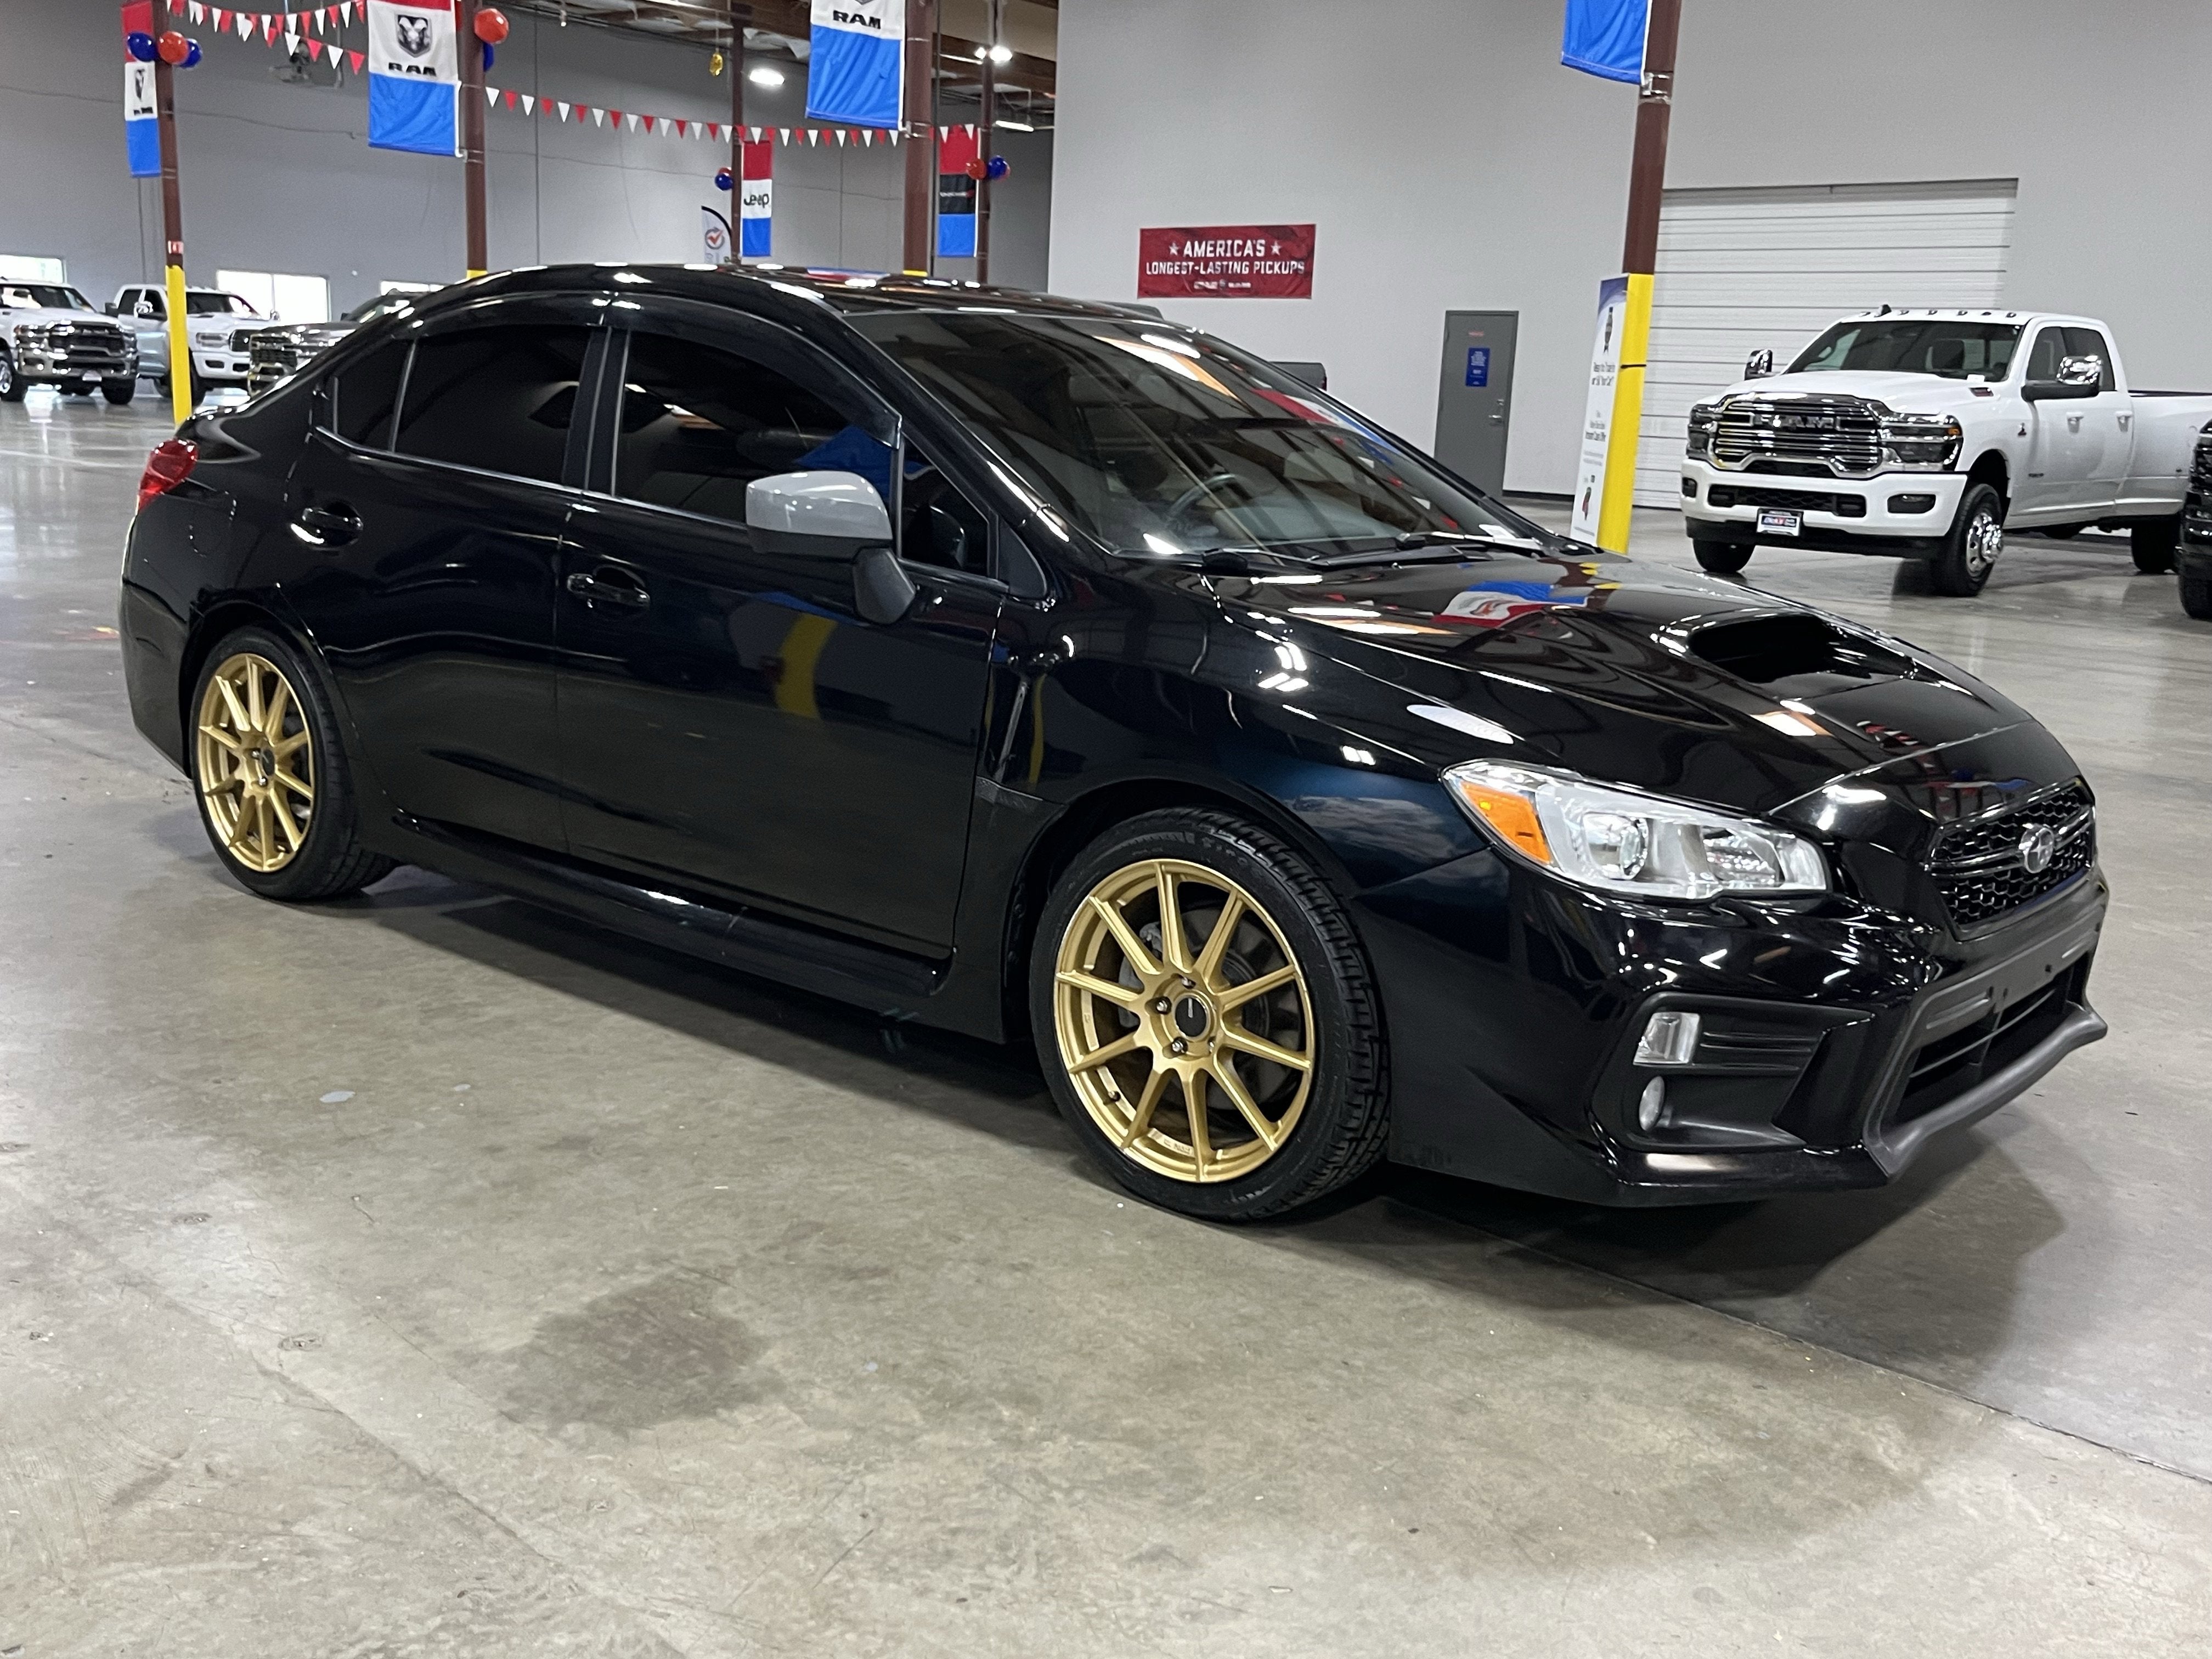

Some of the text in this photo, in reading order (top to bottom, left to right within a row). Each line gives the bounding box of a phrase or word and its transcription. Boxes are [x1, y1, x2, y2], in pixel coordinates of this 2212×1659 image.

[833, 10, 881, 29] RAM
[388, 62, 437, 77] RAM
[743, 193, 770, 208] Jeep
[1183, 239, 1266, 257] AMERICA'S
[1146, 261, 1305, 275] LONGEST-LASTING PICKUPS
